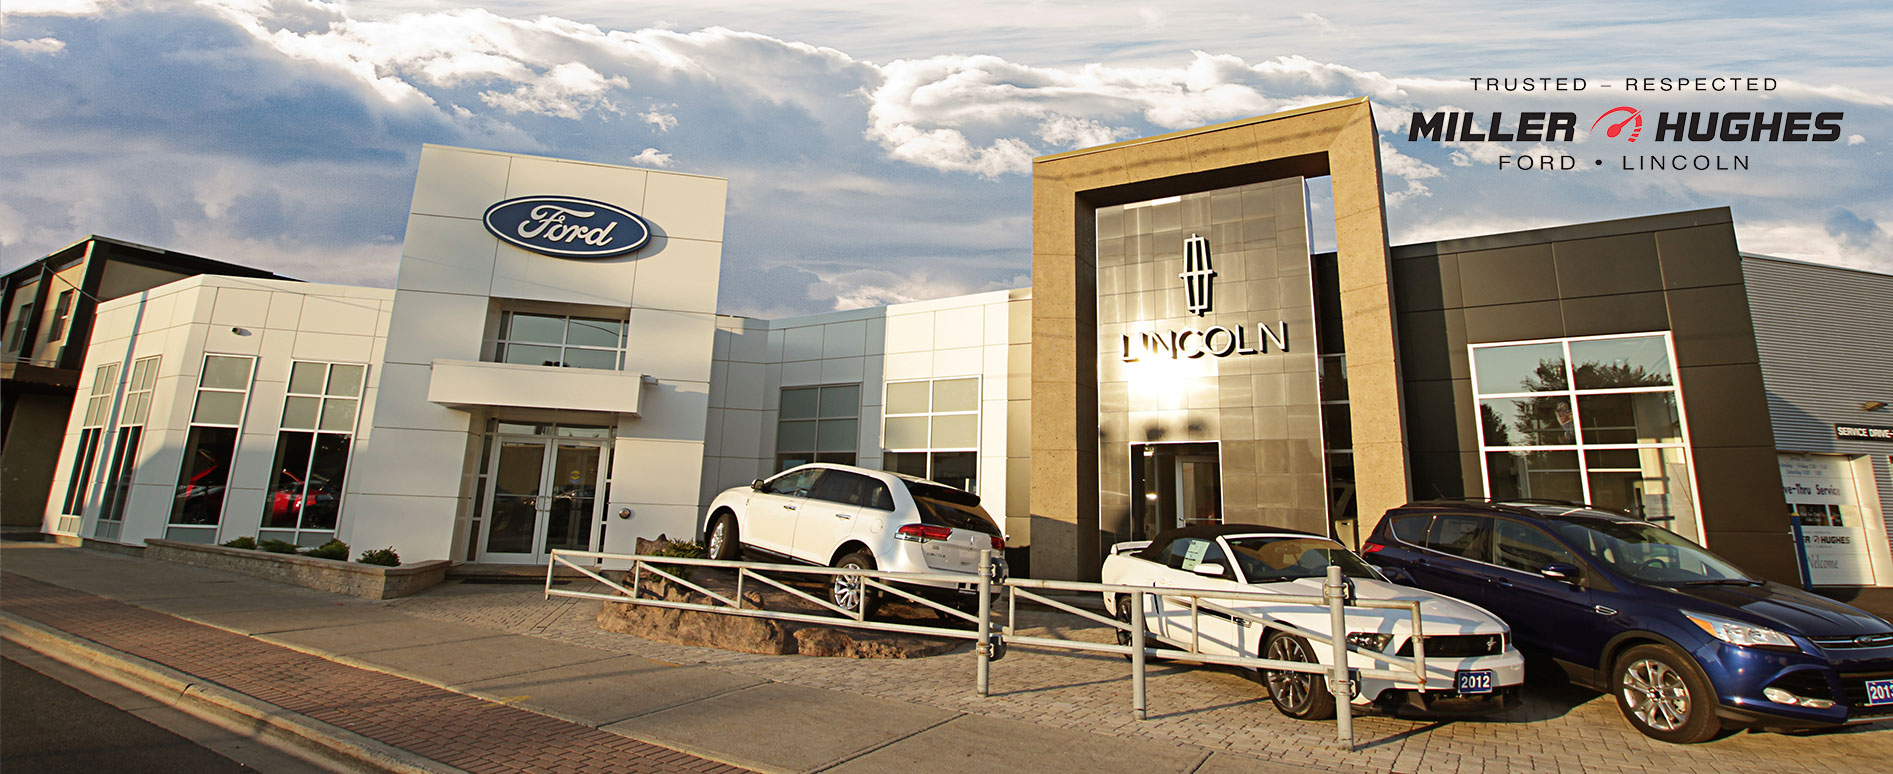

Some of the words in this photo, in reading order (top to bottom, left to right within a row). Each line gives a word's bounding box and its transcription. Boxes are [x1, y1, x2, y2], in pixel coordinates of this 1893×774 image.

[517, 204, 618, 246] Ford
[1120, 319, 1290, 363] LINCOLN
[1836, 426, 1869, 437] SERVICE
[1868, 428, 1893, 438] DRIVE-
[1820, 535, 1851, 545] HUGHES
[1461, 675, 1491, 689] 2012
